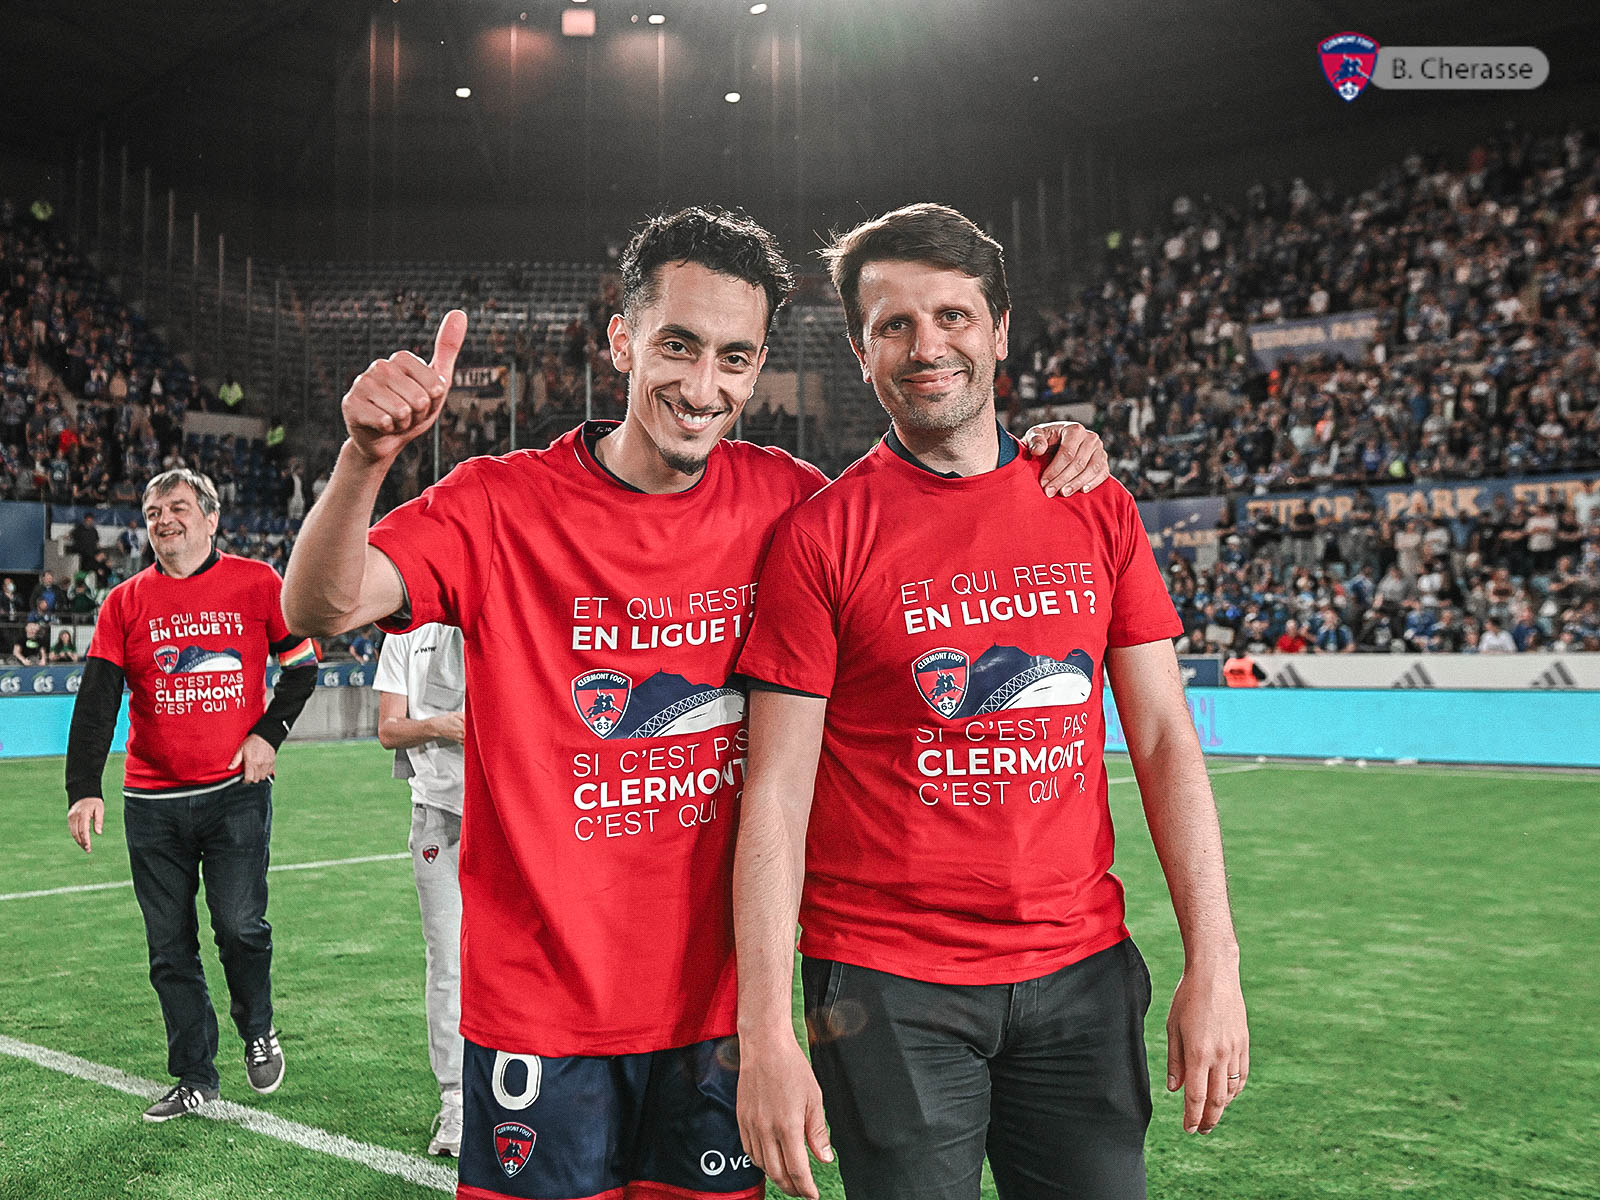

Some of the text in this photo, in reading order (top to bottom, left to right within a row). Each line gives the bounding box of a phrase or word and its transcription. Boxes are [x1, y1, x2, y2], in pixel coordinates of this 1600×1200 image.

[900, 562, 1094, 605] ET QUI RESTE
[573, 582, 759, 622] ET QUI RESTE
[904, 603, 952, 635] EN
[961, 590, 1061, 627] LIGUE
[148, 611, 242, 631] ET QUI RESTE
[150, 627, 171, 643] EN
[175, 623, 221, 638] LIGUE
[572, 626, 619, 650] EN
[631, 617, 725, 650] LIGUE
[917, 652, 965, 670] CLERMONT FOOT
[155, 672, 244, 689] SI C'EST PAS
[155, 684, 244, 703] CLERMONT
[577, 673, 627, 687] CLERMONT FOOT
[154, 702, 193, 715] C'EST
[202, 700, 227, 713] QUI
[941, 701, 954, 711] 63
[596, 722, 610, 730] 63
[916, 727, 943, 744] SI
[965, 717, 1051, 742] C'EST
[1062, 712, 1089, 739] PAS
[573, 752, 600, 778] SI
[619, 743, 700, 773] C'EST
[917, 739, 1086, 777] CLERMONT
[573, 757, 748, 811] CLERMONT
[918, 781, 1011, 807] C'EST
[1029, 776, 1060, 804] QUI
[574, 799, 718, 842] C'EST QUI
